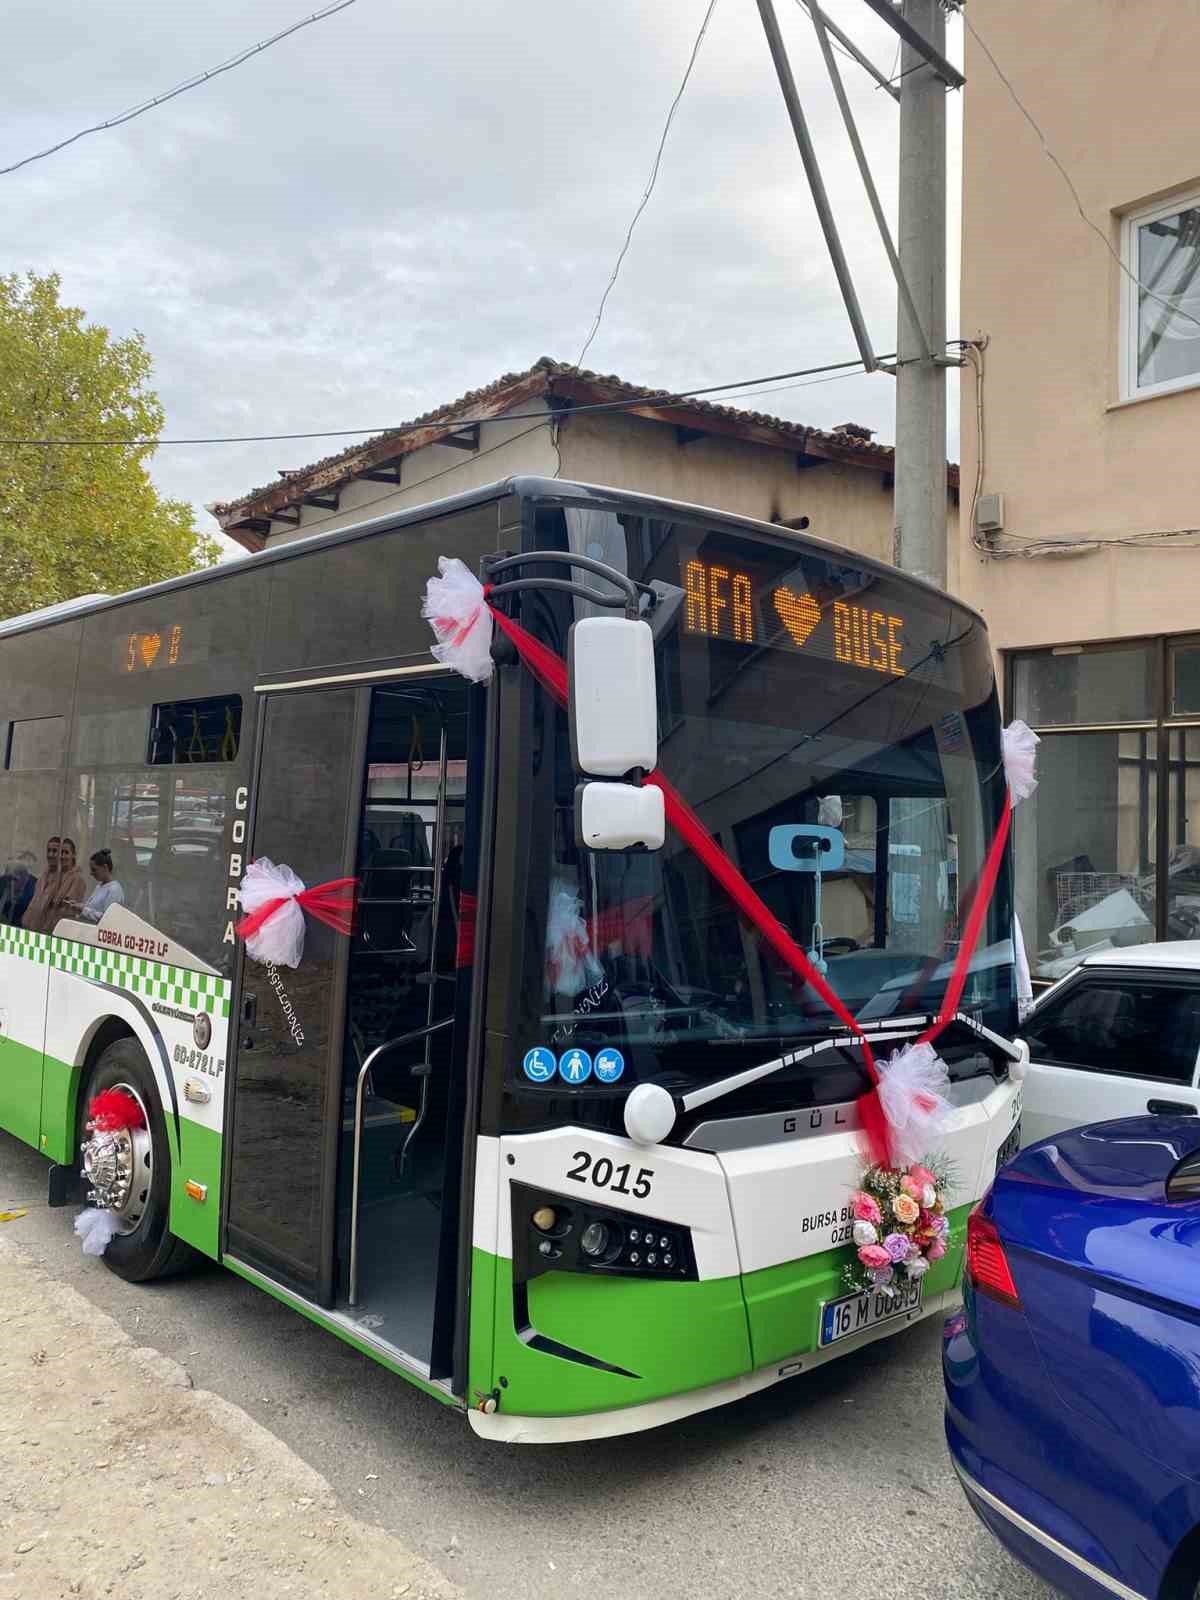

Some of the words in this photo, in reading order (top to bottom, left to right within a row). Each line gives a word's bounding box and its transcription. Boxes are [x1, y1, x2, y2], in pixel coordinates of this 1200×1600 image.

[833, 601, 906, 677] BUSE
[222, 786, 248, 945] COBRA
[98, 929, 122, 947] COBRA
[157, 942, 168, 957] LF
[566, 1151, 655, 1199] 2015
[802, 1210, 838, 1233] BURSA
[834, 1304, 851, 1335] 16
[856, 1297, 869, 1327] M
